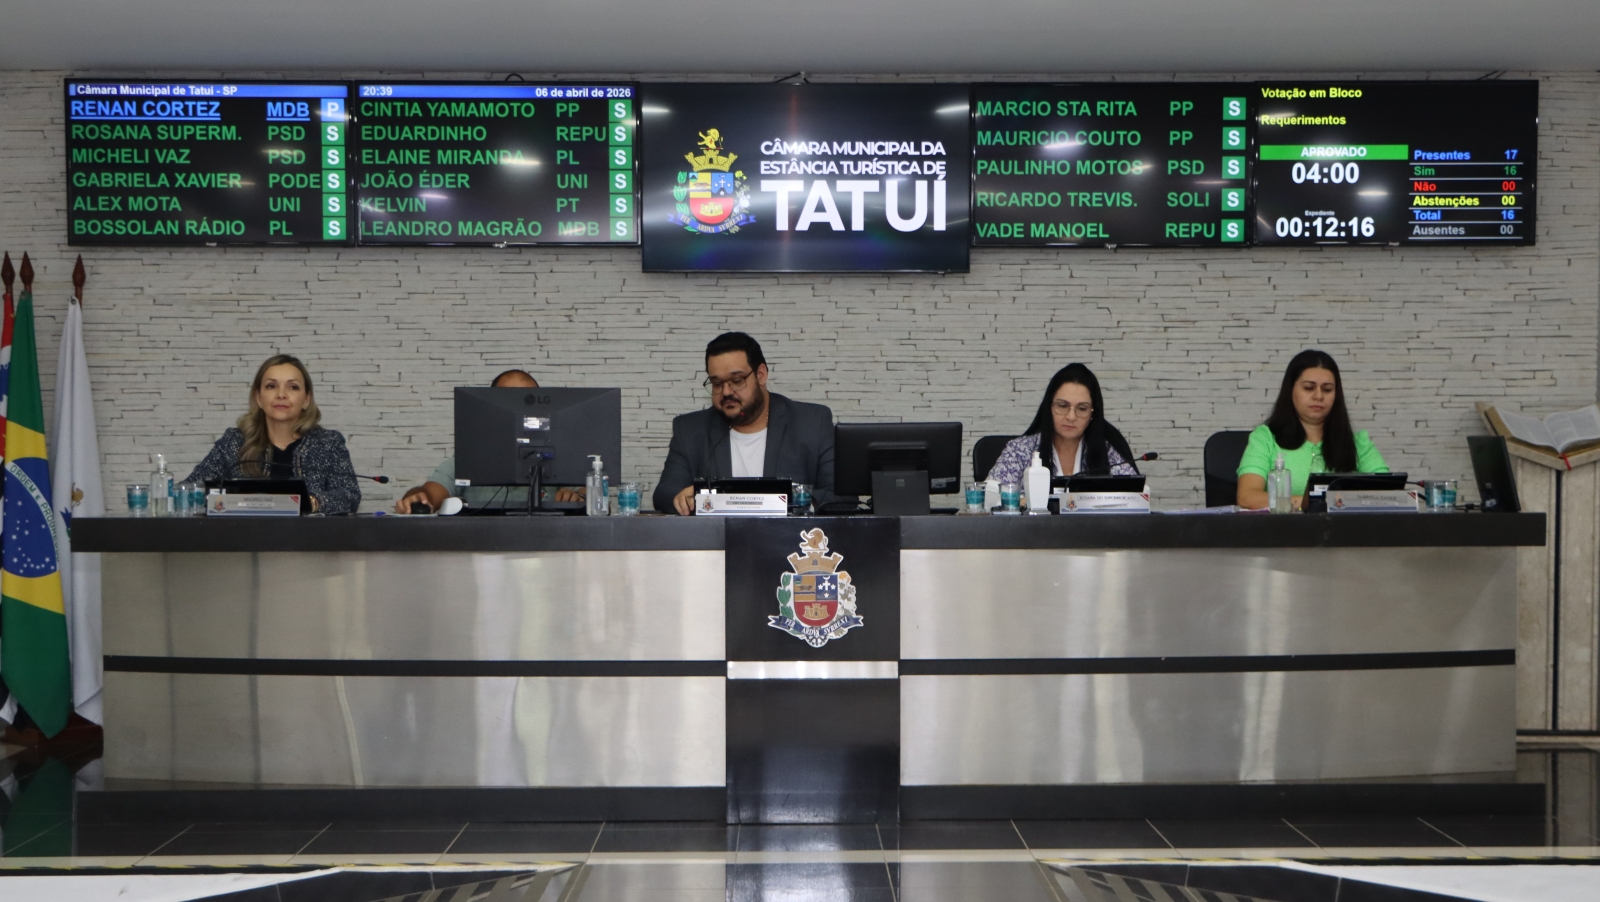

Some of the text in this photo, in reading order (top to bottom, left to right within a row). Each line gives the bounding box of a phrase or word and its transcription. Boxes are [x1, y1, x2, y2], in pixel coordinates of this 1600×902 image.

[77, 85, 118, 95] Câmara
[120, 85, 170, 97] Municipal
[172, 86, 186, 95] de
[222, 86, 238, 96] SP
[363, 86, 393, 96] 20:39
[535, 88, 631, 98] 06 de abril de 2026
[1262, 88, 1362, 100] Votação em Bloco
[71, 101, 340, 118] RENAN CORTEZ MDB P
[360, 102, 626, 118] CINTIA YAMAMOTO PP S
[976, 100, 1241, 116] MARCIO STA RITA PP S
[1262, 116, 1346, 127] Requerimentos
[72, 125, 339, 141] ROSANA SUPERM. PSD S
[361, 126, 626, 142] EDUARDINHO REPU S
[976, 130, 1240, 146] MAURICIO COUTO PP S
[760, 138, 946, 156] CÂMARA MUNICIPAL DA
[1300, 146, 1367, 158] APROVADO
[1414, 150, 1518, 160] Presentes 17
[72, 149, 340, 165] MICHELI VAZ PSD S
[362, 150, 627, 166] ELAINE MIRANDA PL S
[760, 157, 946, 174] ESTÂNCIA TURÍSTICA DE
[976, 160, 1240, 176] PAULINHO MOTOS PSD S
[1292, 162, 1360, 184] 04:00
[1414, 166, 1517, 176] Sim 16
[72, 173, 340, 189] GABRIELA XAVIER PODE S
[360, 170, 627, 190] JOÃO ÉDER UNI S
[1414, 180, 1516, 192] Não 00
[73, 196, 340, 212] ALEX MOTA UNI S
[362, 198, 628, 213] KELVIN PT S
[760, 174, 946, 232] TATUÍ
[976, 192, 1240, 208] RICARDO TREVIS. SOLI S
[1413, 195, 1516, 208] Abstenções 00
[680, 214, 691, 224] PER
[1413, 210, 1514, 220] Total 16
[74, 216, 341, 236] BOSSOLAN RÁDIO PL S
[362, 218, 628, 237] LEANDRO MAGRÃO MDB S
[976, 222, 1239, 238] VADE MANOEL REPU S
[1276, 216, 1374, 238] 00:12:16
[1412, 224, 1514, 236] Ausentes 00
[537, 396, 550, 404] LG
[10, 464, 36, 493] ORDEM
[784, 619, 796, 627] PER
